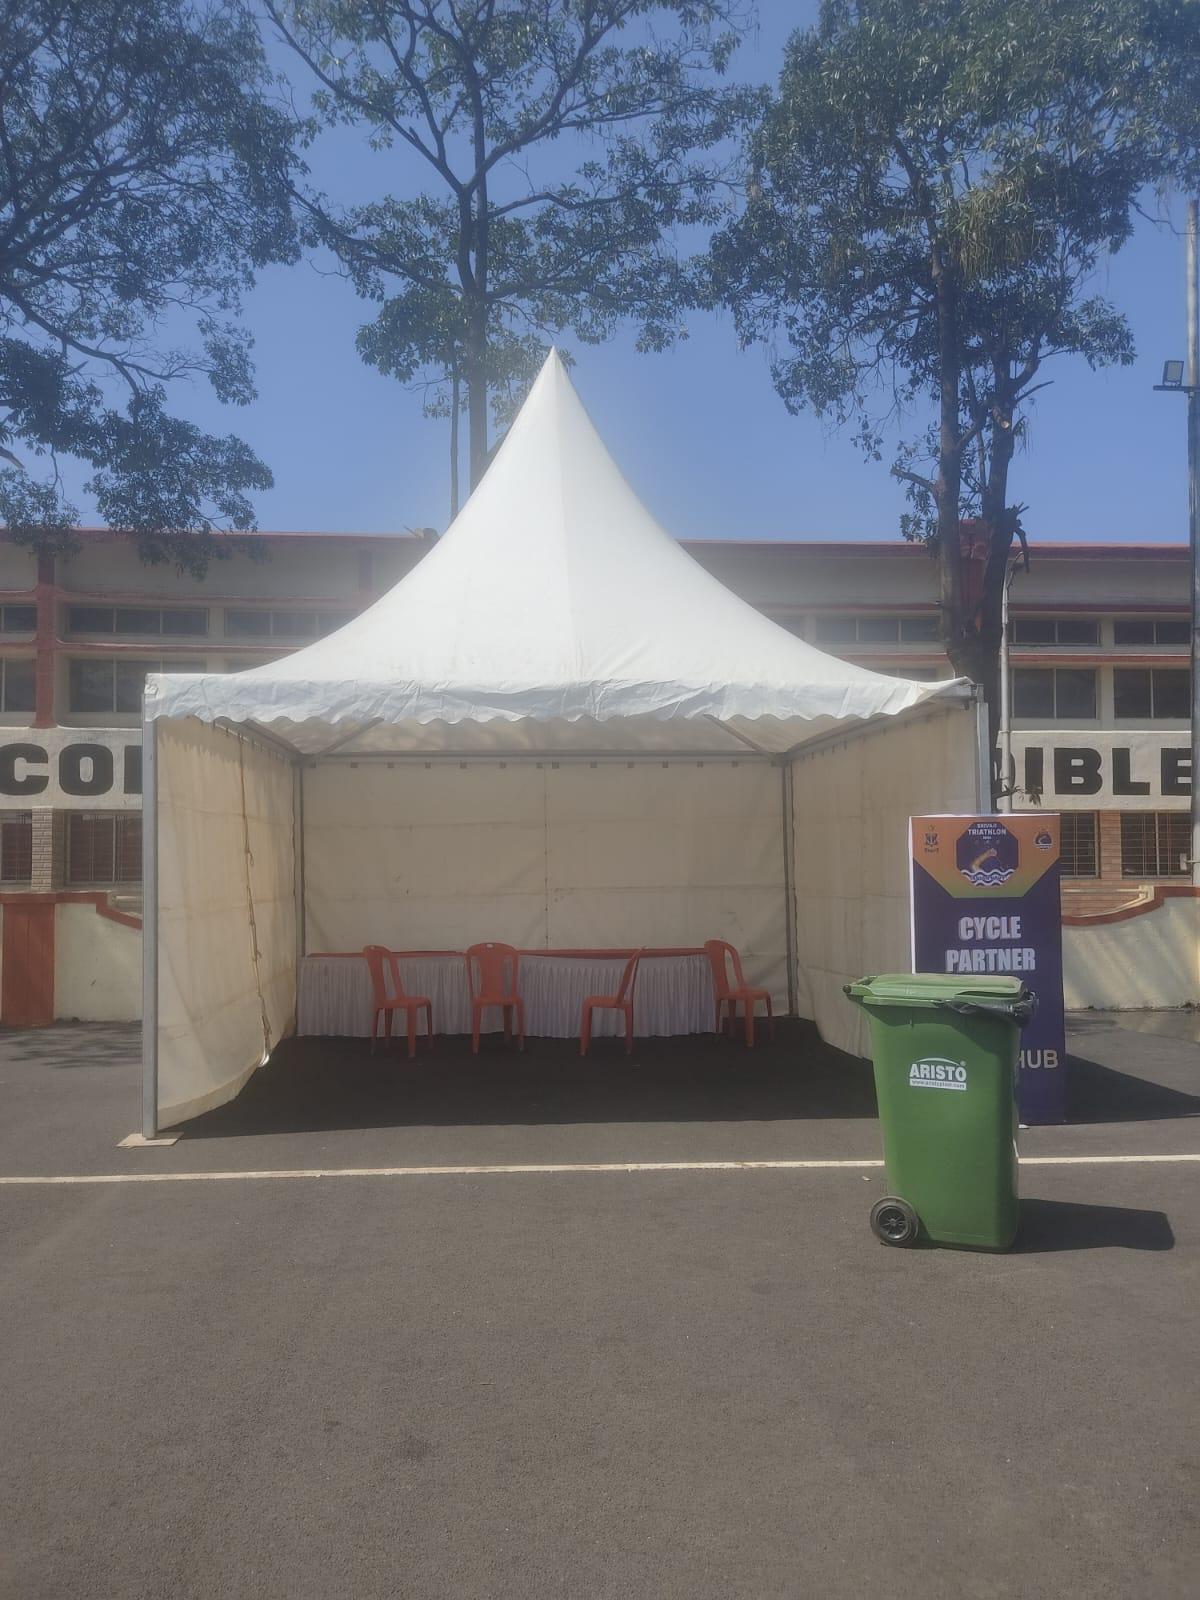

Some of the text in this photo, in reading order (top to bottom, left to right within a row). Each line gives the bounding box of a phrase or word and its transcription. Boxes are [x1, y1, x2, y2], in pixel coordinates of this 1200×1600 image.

[967, 828, 1007, 836] TRIATHLON
[958, 916, 1022, 941] CYCLE
[945, 948, 1036, 973] PARTNER
[909, 1063, 967, 1082] ARISTO
